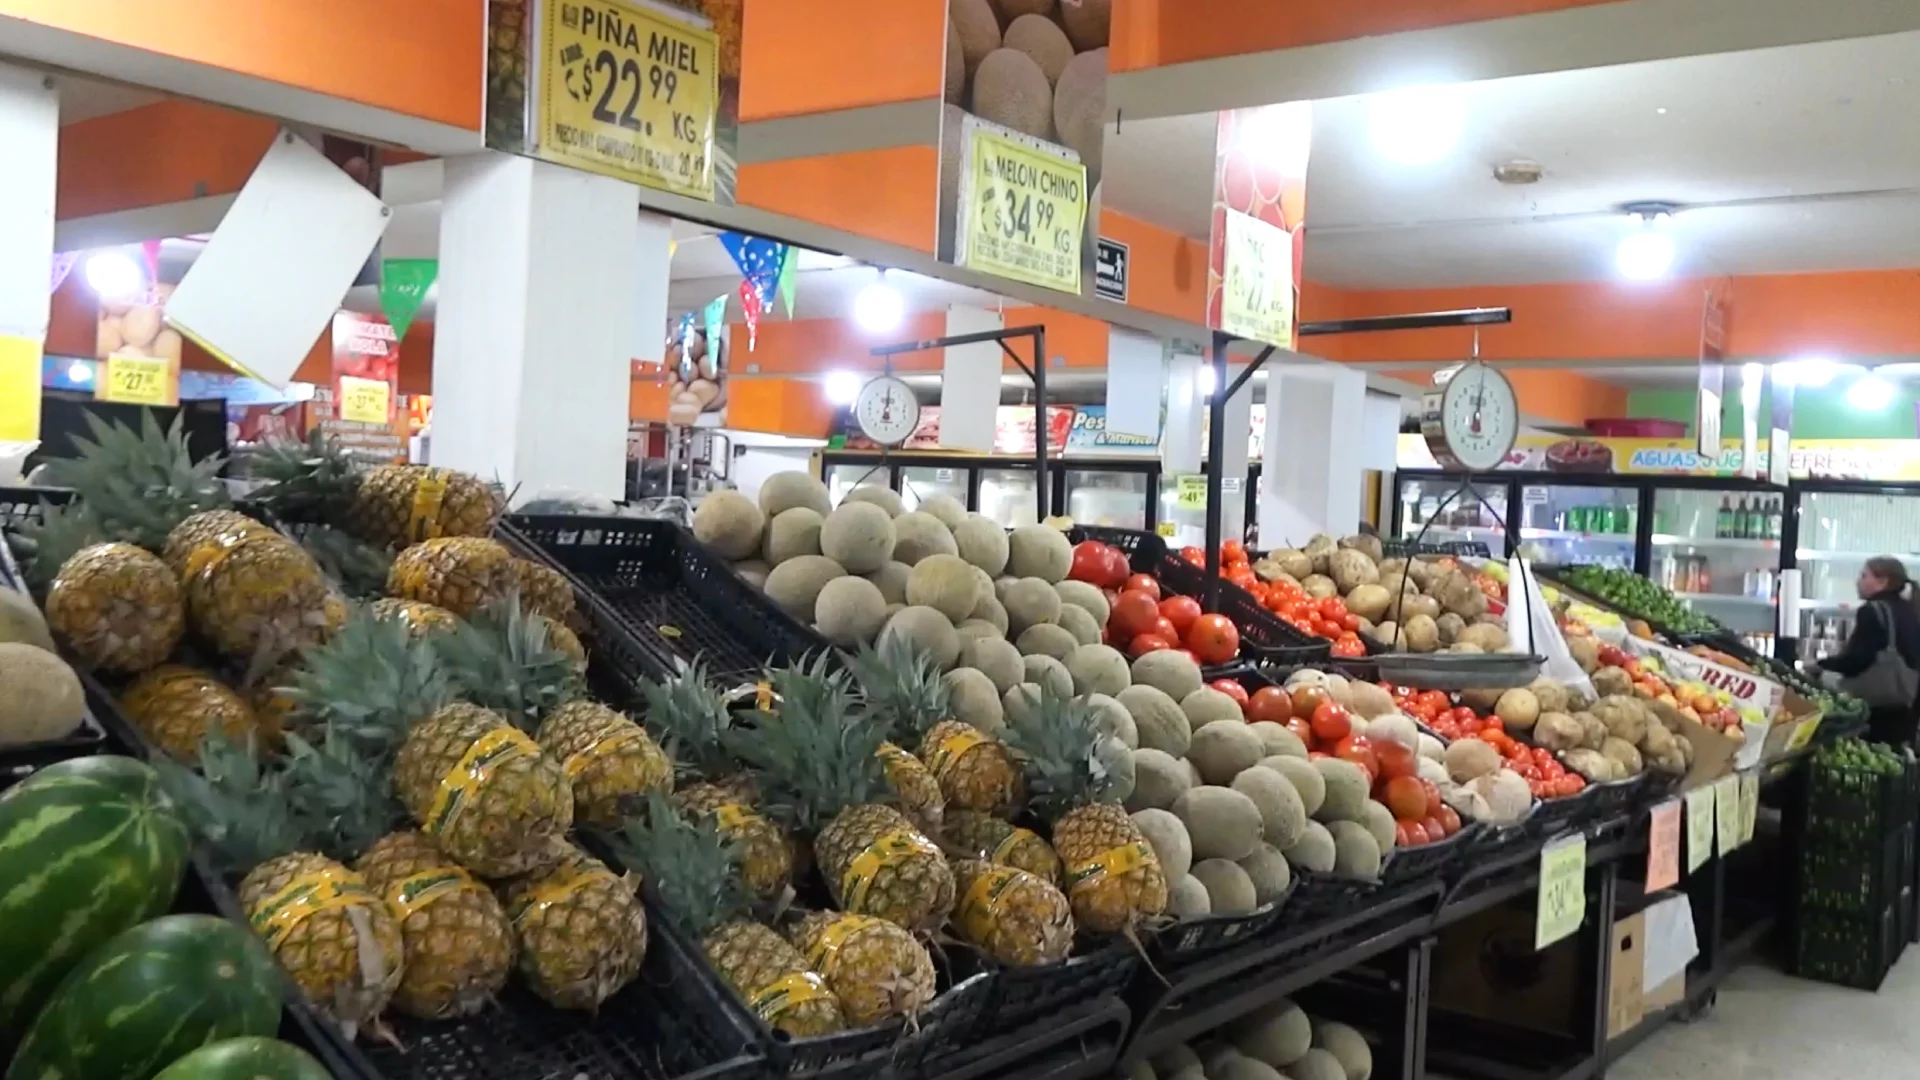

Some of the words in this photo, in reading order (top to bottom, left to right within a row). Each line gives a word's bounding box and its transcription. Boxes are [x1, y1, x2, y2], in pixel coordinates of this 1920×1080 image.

[582, 5, 640, 54] PIÑA
[648, 32, 700, 75] MIEL
[997, 156, 1037, 190] MELON
[1040, 170, 1079, 203] CHINO
[1073, 411, 1106, 430] Pes
[1632, 449, 1698, 467] AGUAS
[1701, 453, 1769, 470] JUGS
[1702, 668, 1757, 699] RED
